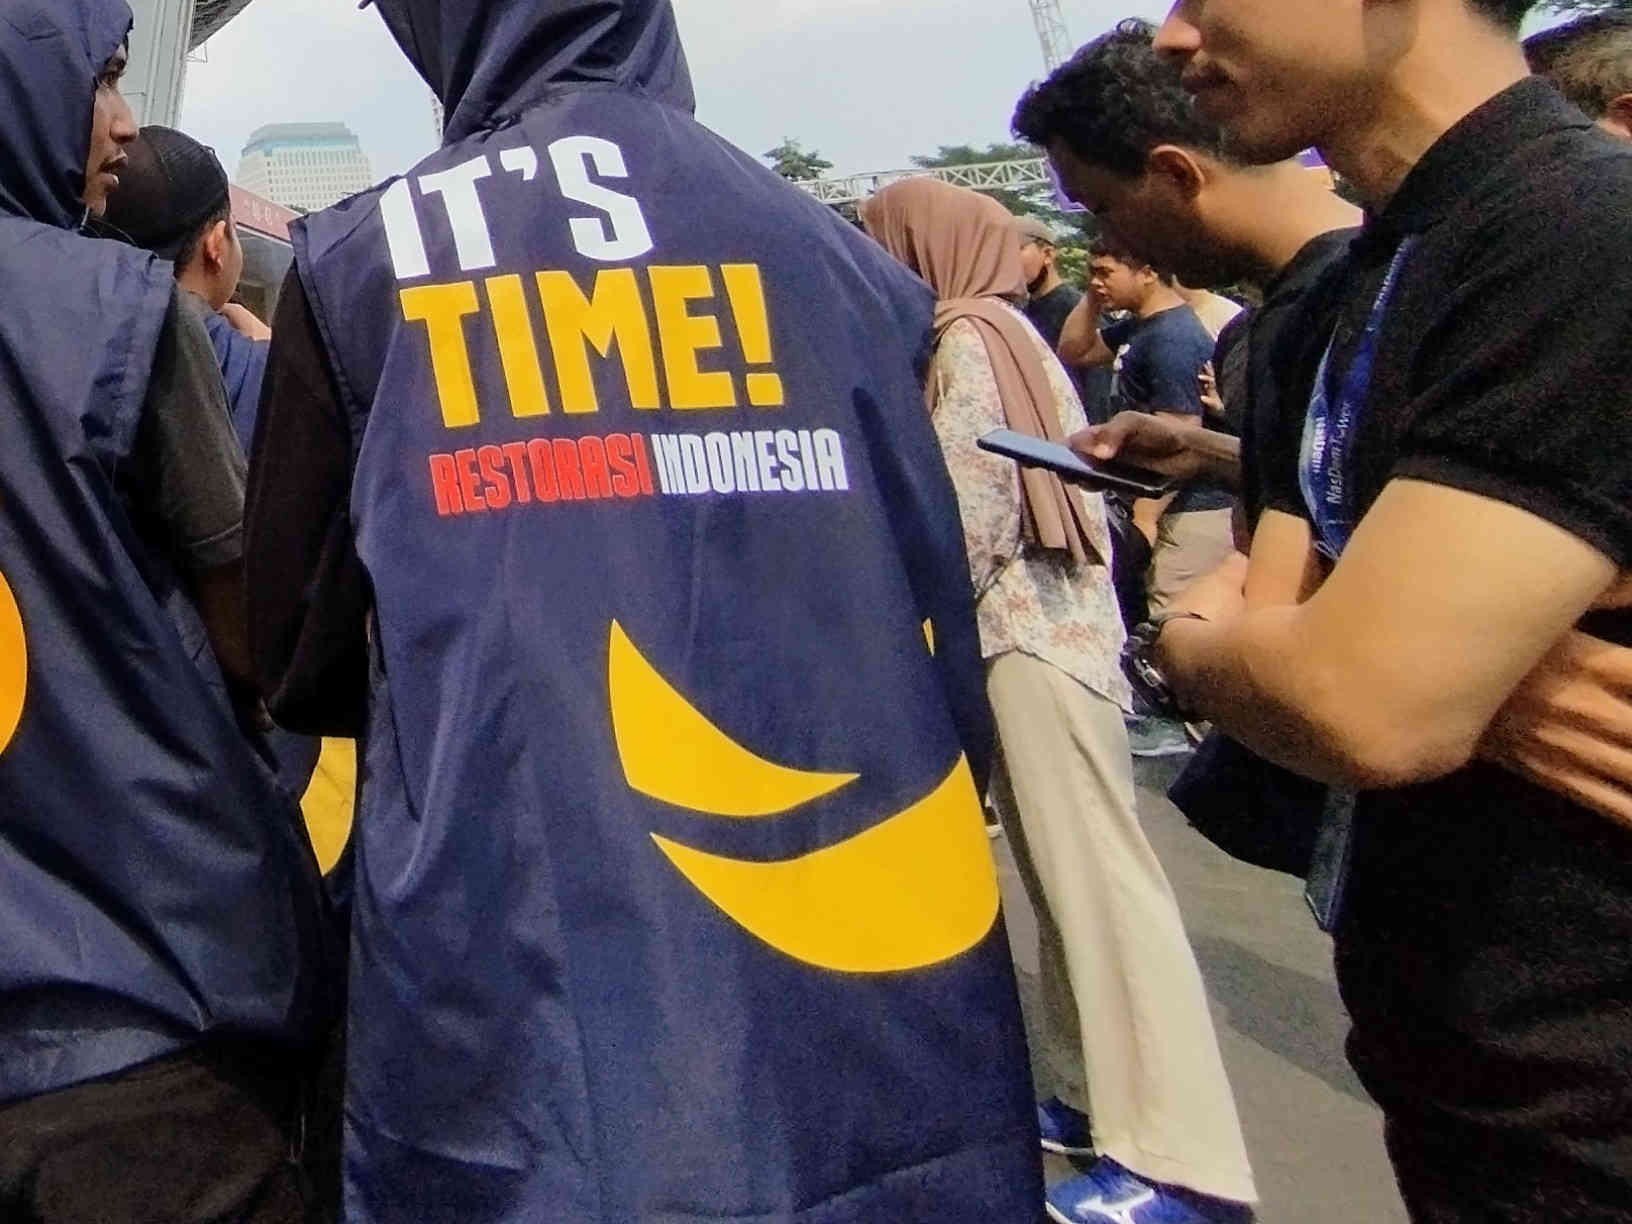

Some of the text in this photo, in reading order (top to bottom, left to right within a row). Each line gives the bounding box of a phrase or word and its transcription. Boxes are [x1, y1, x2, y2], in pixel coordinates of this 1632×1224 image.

[379, 135, 654, 280] IT'S
[399, 263, 784, 429] TIME!
[428, 428, 850, 517] RESTORASI INDONESIA
